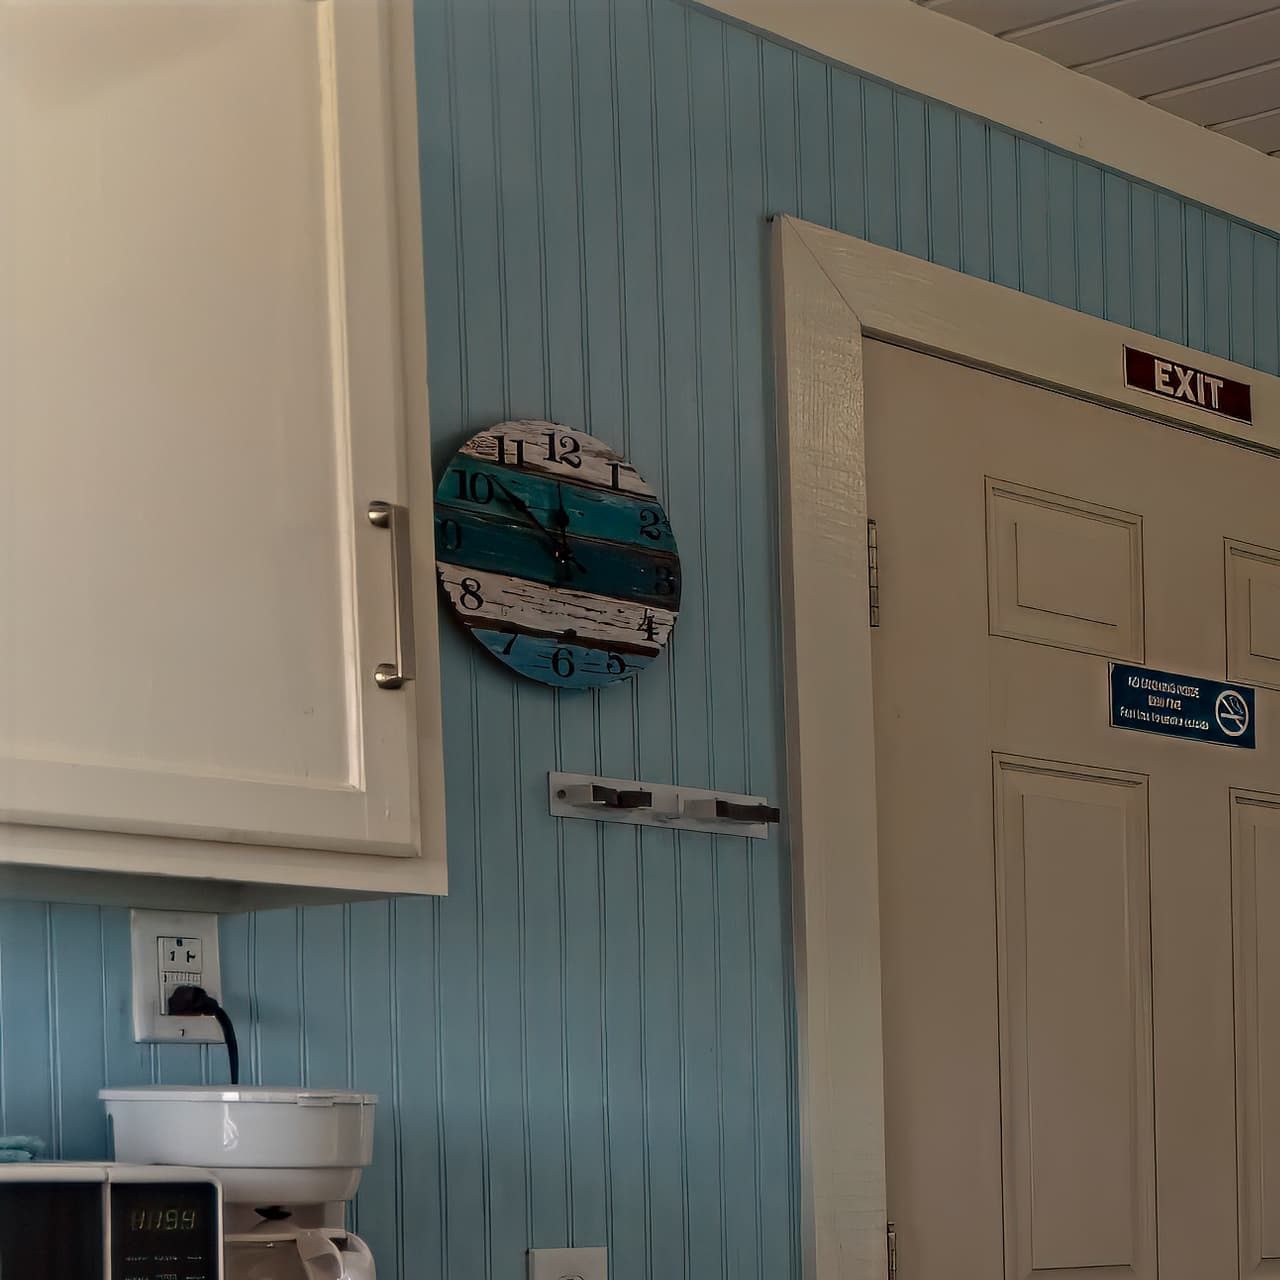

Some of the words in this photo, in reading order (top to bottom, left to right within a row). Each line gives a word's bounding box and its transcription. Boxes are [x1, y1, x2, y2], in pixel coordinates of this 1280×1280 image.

[1154, 359, 1223, 409] EXIT
[492, 435, 524, 467] 11
[543, 431, 582, 469] 12
[452, 468, 494, 505] 10
[607, 462, 620, 490] 1
[639, 508, 664, 540] 2
[459, 577, 484, 611] 8
[637, 609, 659, 642] 4
[552, 647, 575, 678] 6
[606, 650, 627, 675] 5
